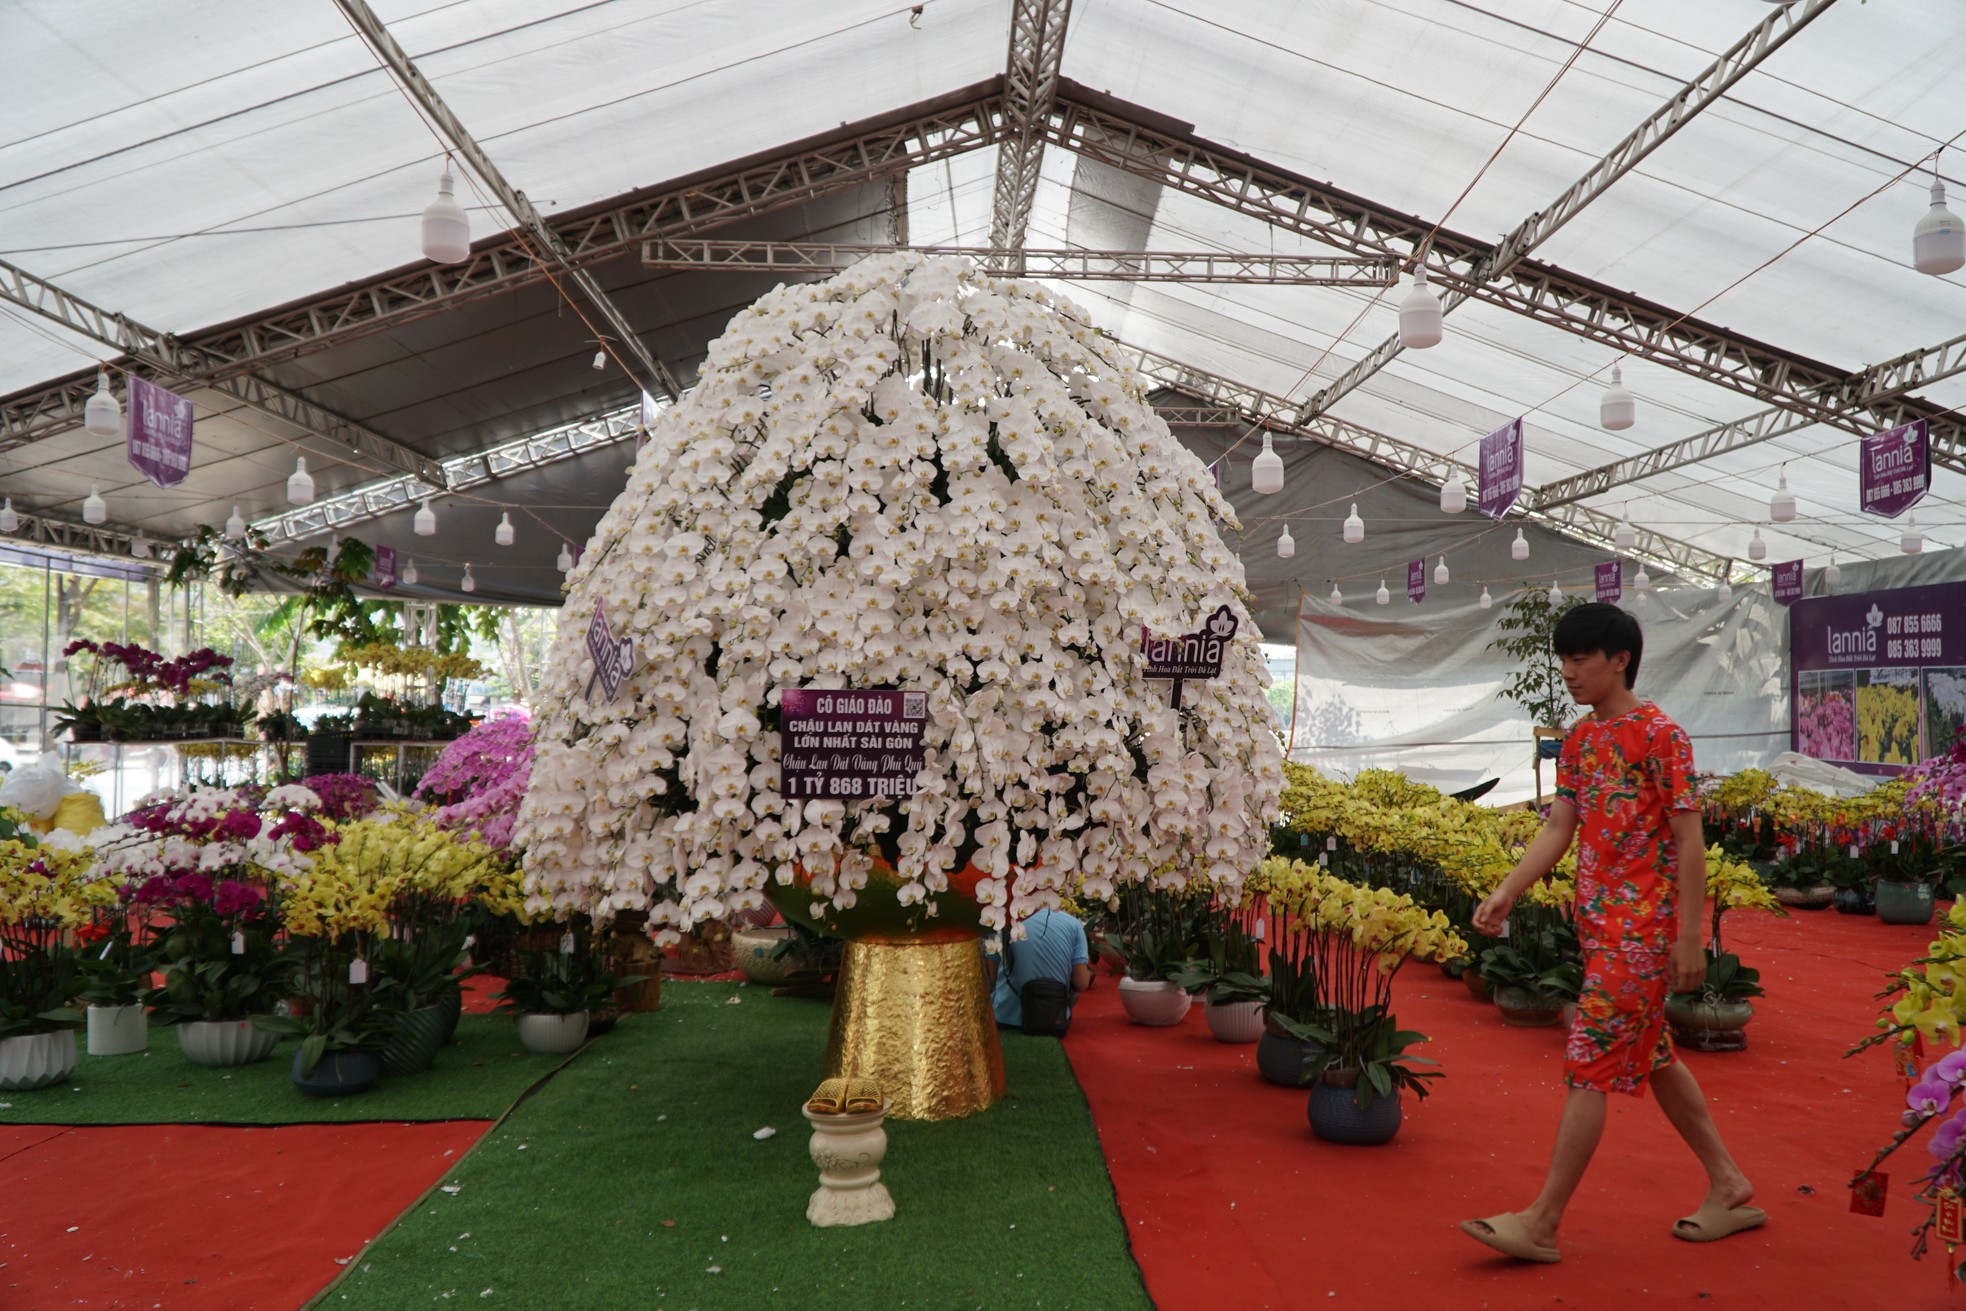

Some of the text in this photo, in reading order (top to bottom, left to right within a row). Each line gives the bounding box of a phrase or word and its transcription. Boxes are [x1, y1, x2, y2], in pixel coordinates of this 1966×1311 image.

[1487, 444, 1513, 473] lannia
[1872, 445, 1913, 473] lannia
[1887, 613, 1942, 634] 087 855 6666
[1827, 626, 1876, 654] lannia
[1887, 638, 1942, 659] 085 363 9999
[1158, 665, 1170, 673] Hoa
[816, 695, 892, 715] CÔ GIÁO ĐÀO
[789, 719, 918, 734] CHẬU LAN DÁT VÀNG
[794, 733, 913, 749] LỚN NHẤT SÀI GÒN
[783, 753, 923, 774] Chậu Lan Dát Vàng Phú Quý
[788, 772, 917, 799] 1 TỶ 868 TRIỆU
